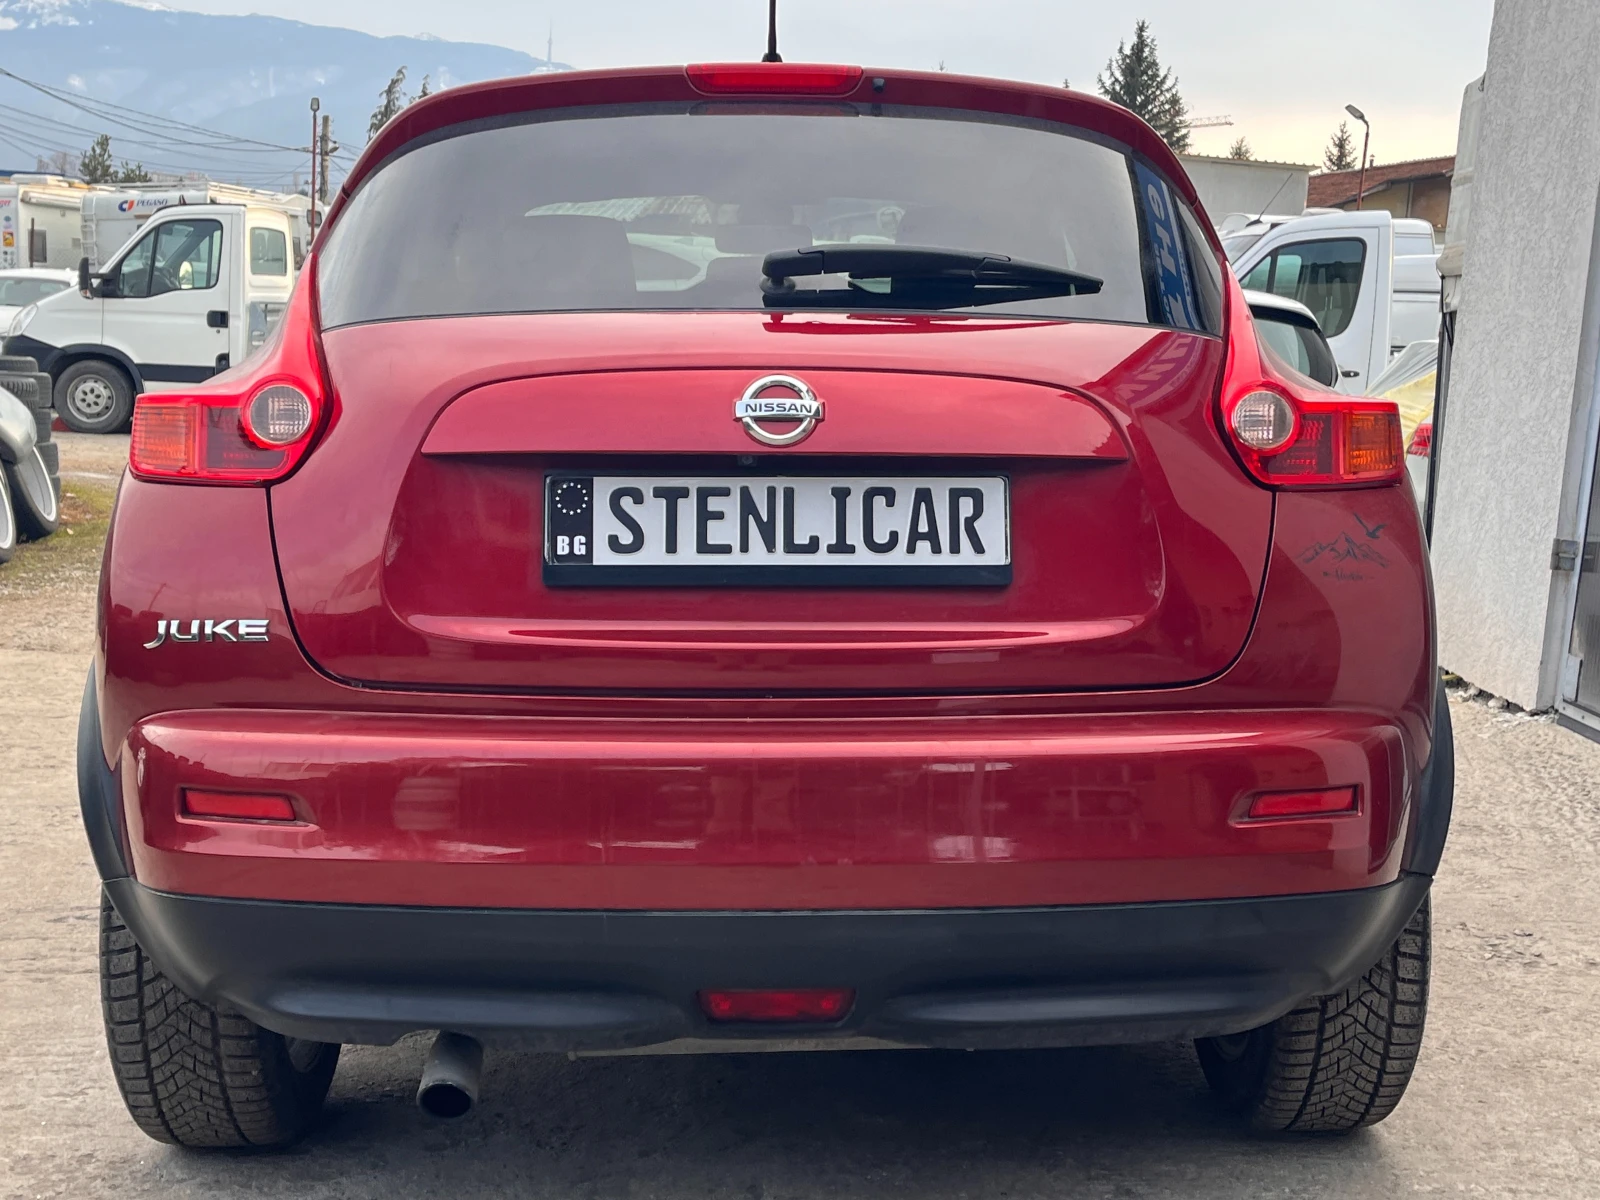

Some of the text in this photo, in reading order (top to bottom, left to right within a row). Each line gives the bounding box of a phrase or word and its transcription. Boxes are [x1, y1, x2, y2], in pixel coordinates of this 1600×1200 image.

[745, 403, 812, 413] NISSAN
[556, 485, 986, 555] BG STENLICAR
[143, 619, 270, 649] JUKE
